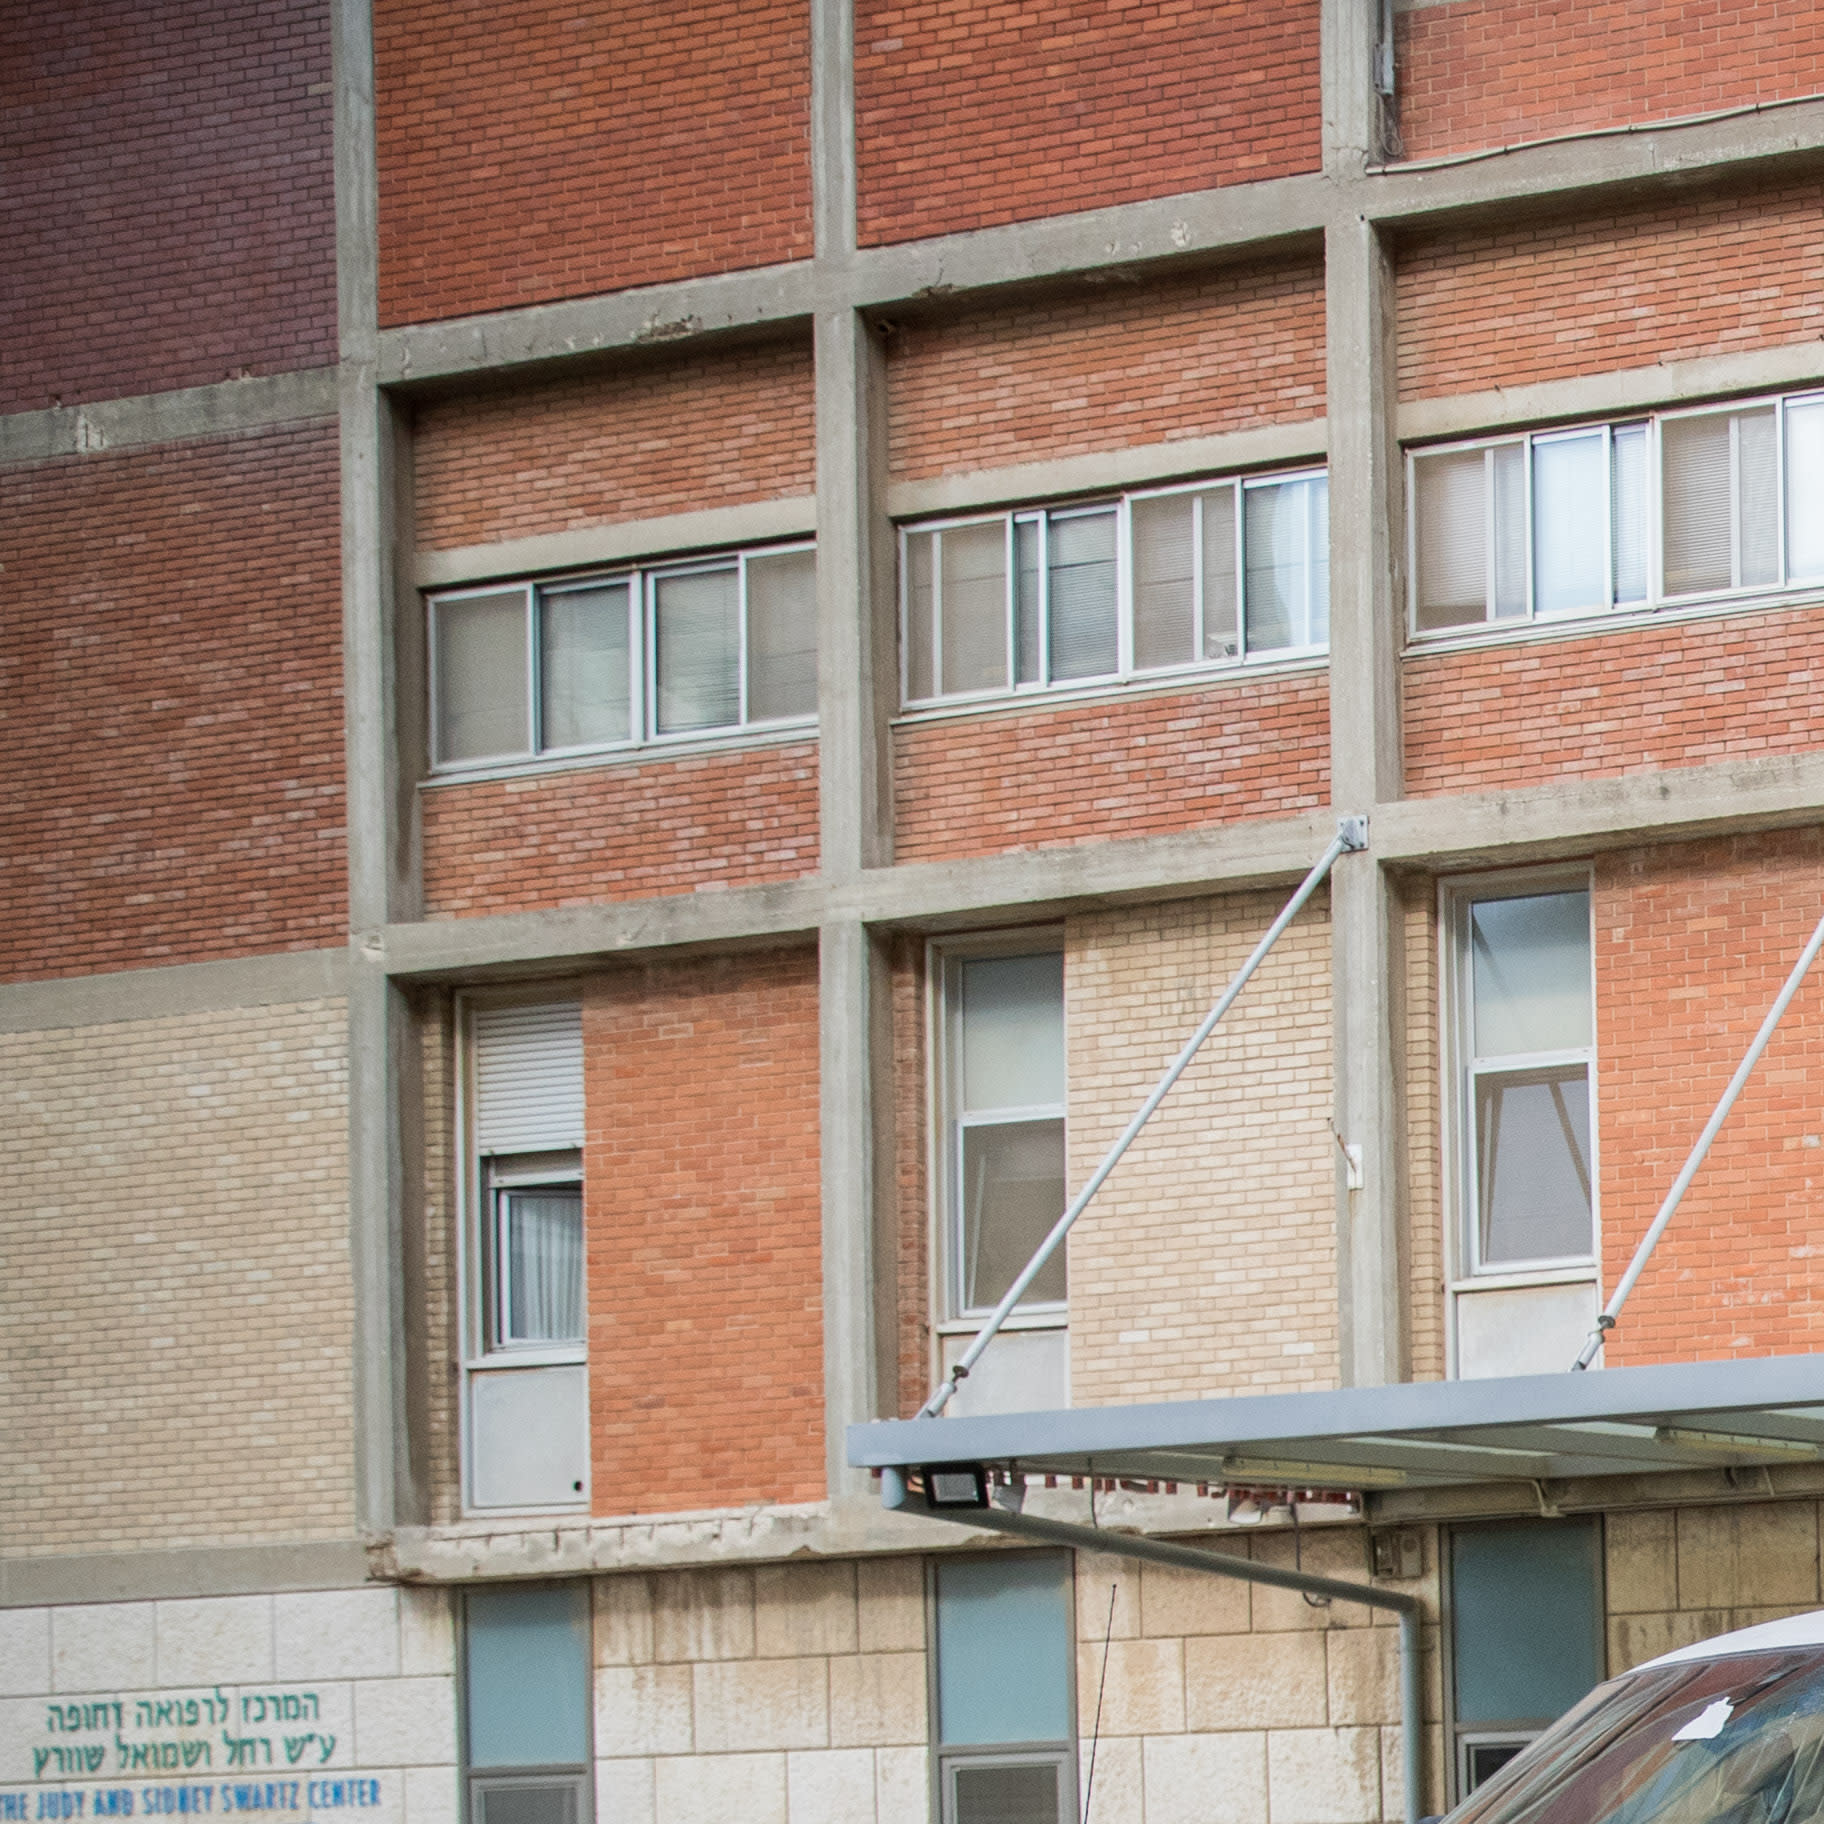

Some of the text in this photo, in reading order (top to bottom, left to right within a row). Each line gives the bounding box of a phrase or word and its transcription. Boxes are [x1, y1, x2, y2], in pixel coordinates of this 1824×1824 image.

[47, 1685, 319, 1733] המרכז לרפואה דחופה
[32, 1746, 105, 1780] שוורץ
[115, 1733, 211, 1769] ושמואל
[222, 1729, 271, 1765] רחל
[36, 1790, 85, 1820] JUDY
[93, 1788, 134, 1816] AND
[142, 1785, 213, 1815] SIDNEY
[221, 1781, 299, 1812] SWARTZ
[308, 1778, 381, 1809] CENTER
